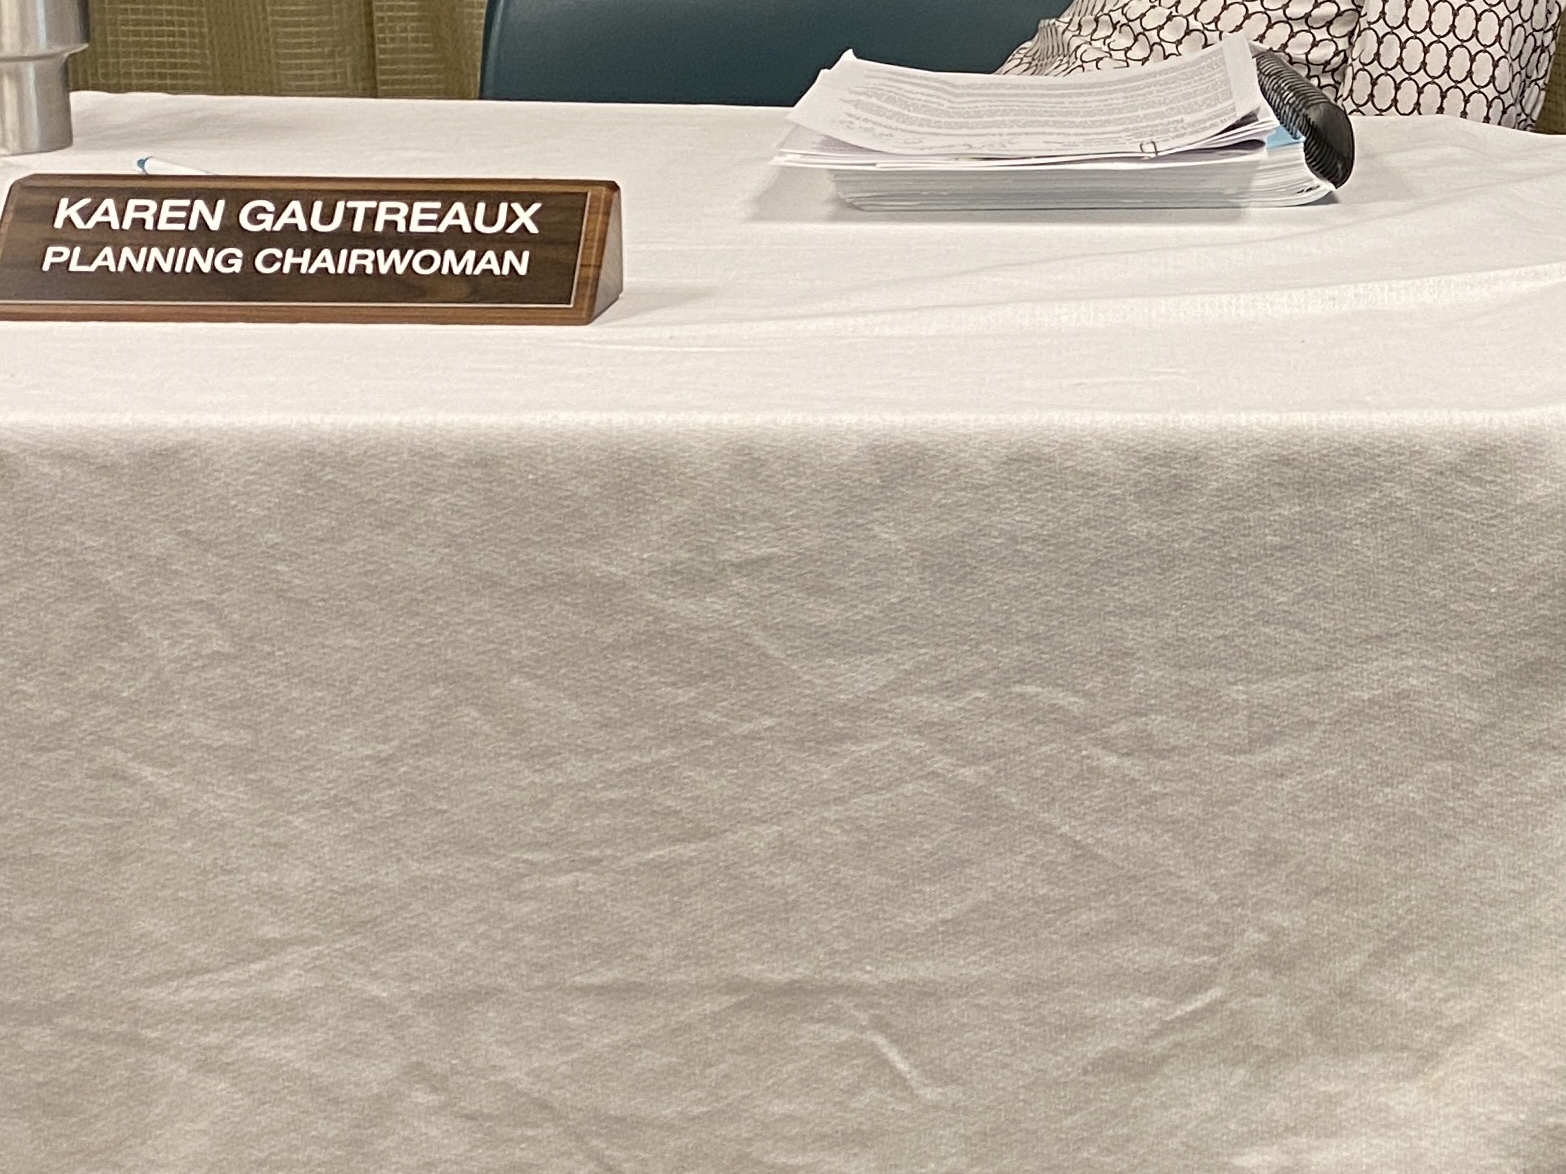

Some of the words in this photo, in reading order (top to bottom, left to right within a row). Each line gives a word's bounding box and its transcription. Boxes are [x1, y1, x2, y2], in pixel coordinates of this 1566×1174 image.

[53, 197, 225, 231] KAREN
[238, 199, 542, 234] GAUTREAUX
[42, 246, 244, 273] PLANNING
[253, 248, 530, 276] CHAIRWOMAN
